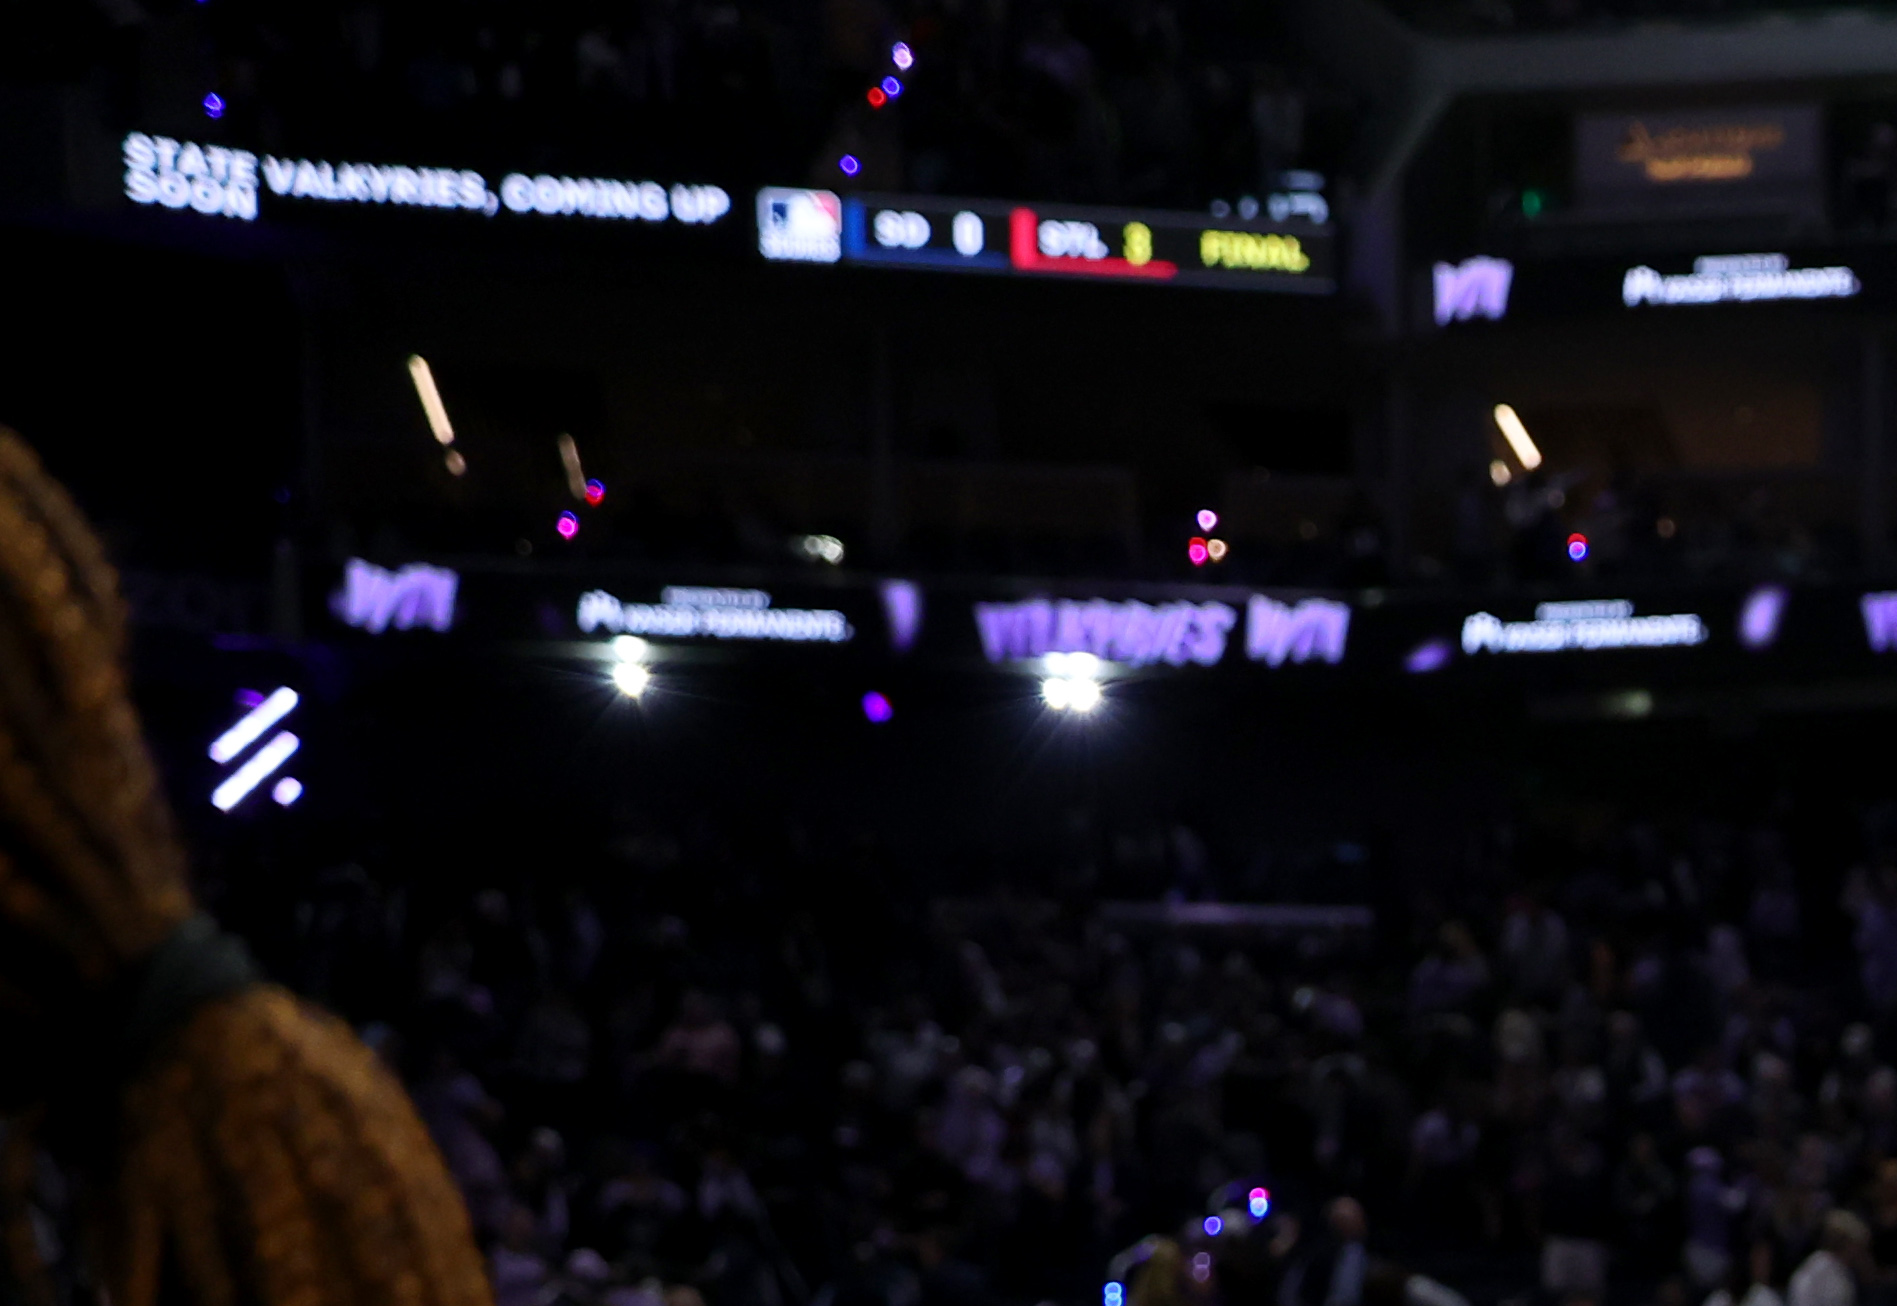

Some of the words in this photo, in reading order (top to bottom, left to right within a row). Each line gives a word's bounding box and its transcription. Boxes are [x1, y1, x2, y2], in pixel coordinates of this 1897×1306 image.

[123, 131, 258, 184] STATE
[501, 172, 668, 222] COMING
[670, 184, 731, 225] UP
[1200, 228, 1311, 273] FINAL
